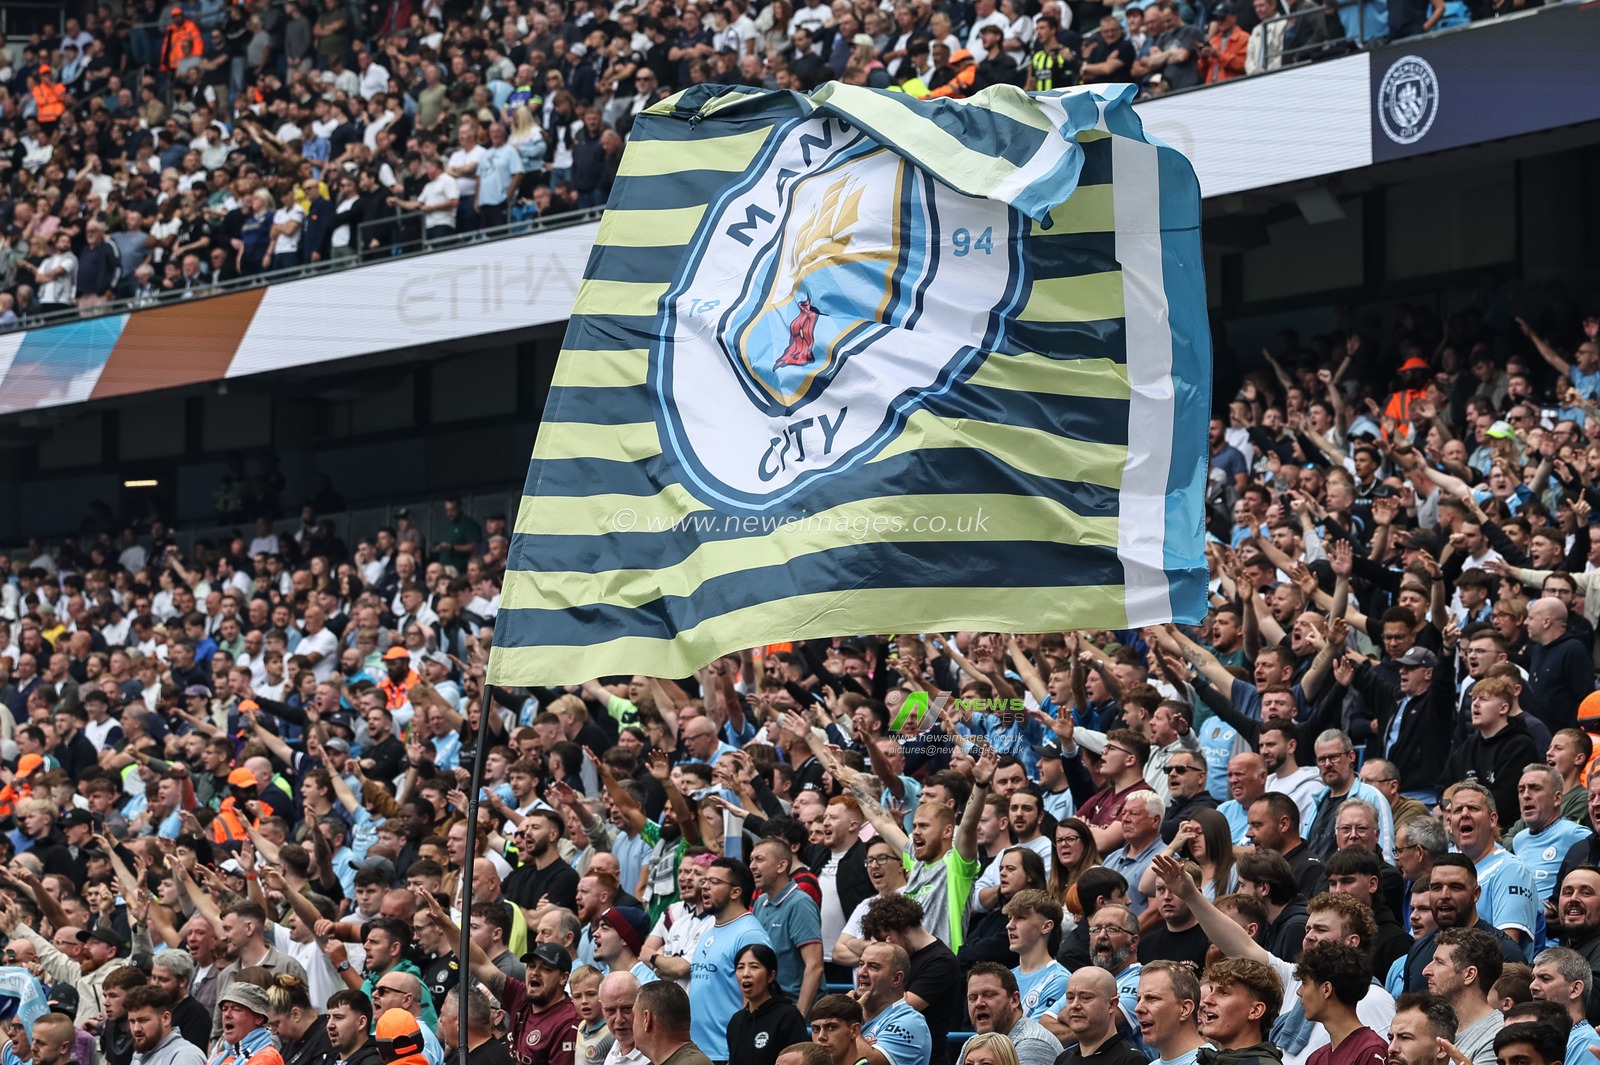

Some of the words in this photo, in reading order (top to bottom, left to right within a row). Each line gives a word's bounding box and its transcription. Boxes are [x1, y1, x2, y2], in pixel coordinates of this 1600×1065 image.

[952, 226, 994, 257] 94
[396, 243, 592, 327] ETIHA
[689, 298, 721, 318] 18
[758, 406, 848, 482] CITY
